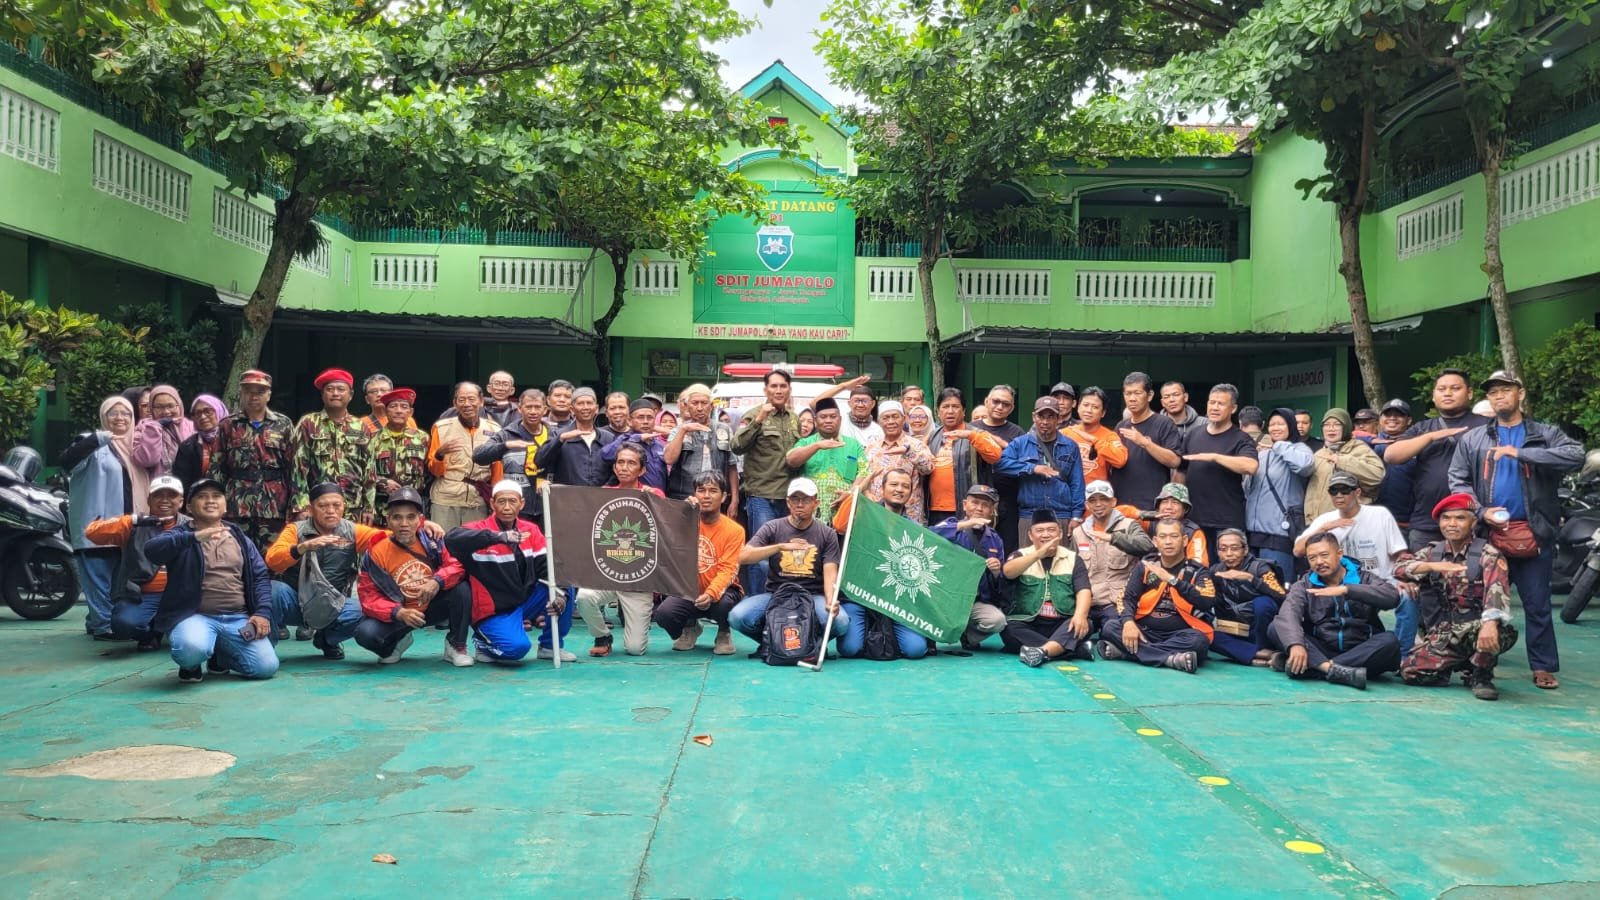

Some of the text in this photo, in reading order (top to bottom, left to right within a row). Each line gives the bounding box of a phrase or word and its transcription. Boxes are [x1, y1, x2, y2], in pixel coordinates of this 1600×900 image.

[781, 201, 836, 212] DATANG
[716, 275, 835, 289] SDIT JUMAPOLO
[710, 326, 726, 337] SDIT
[729, 327, 769, 337] JUMAPOLO
[789, 327, 807, 338] YANG
[1286, 371, 1324, 390] JUMAPOLO
[594, 500, 656, 542] BIKERS MUHAMMADIYAH
[845, 581, 944, 638] MUHAMMADIYAH
